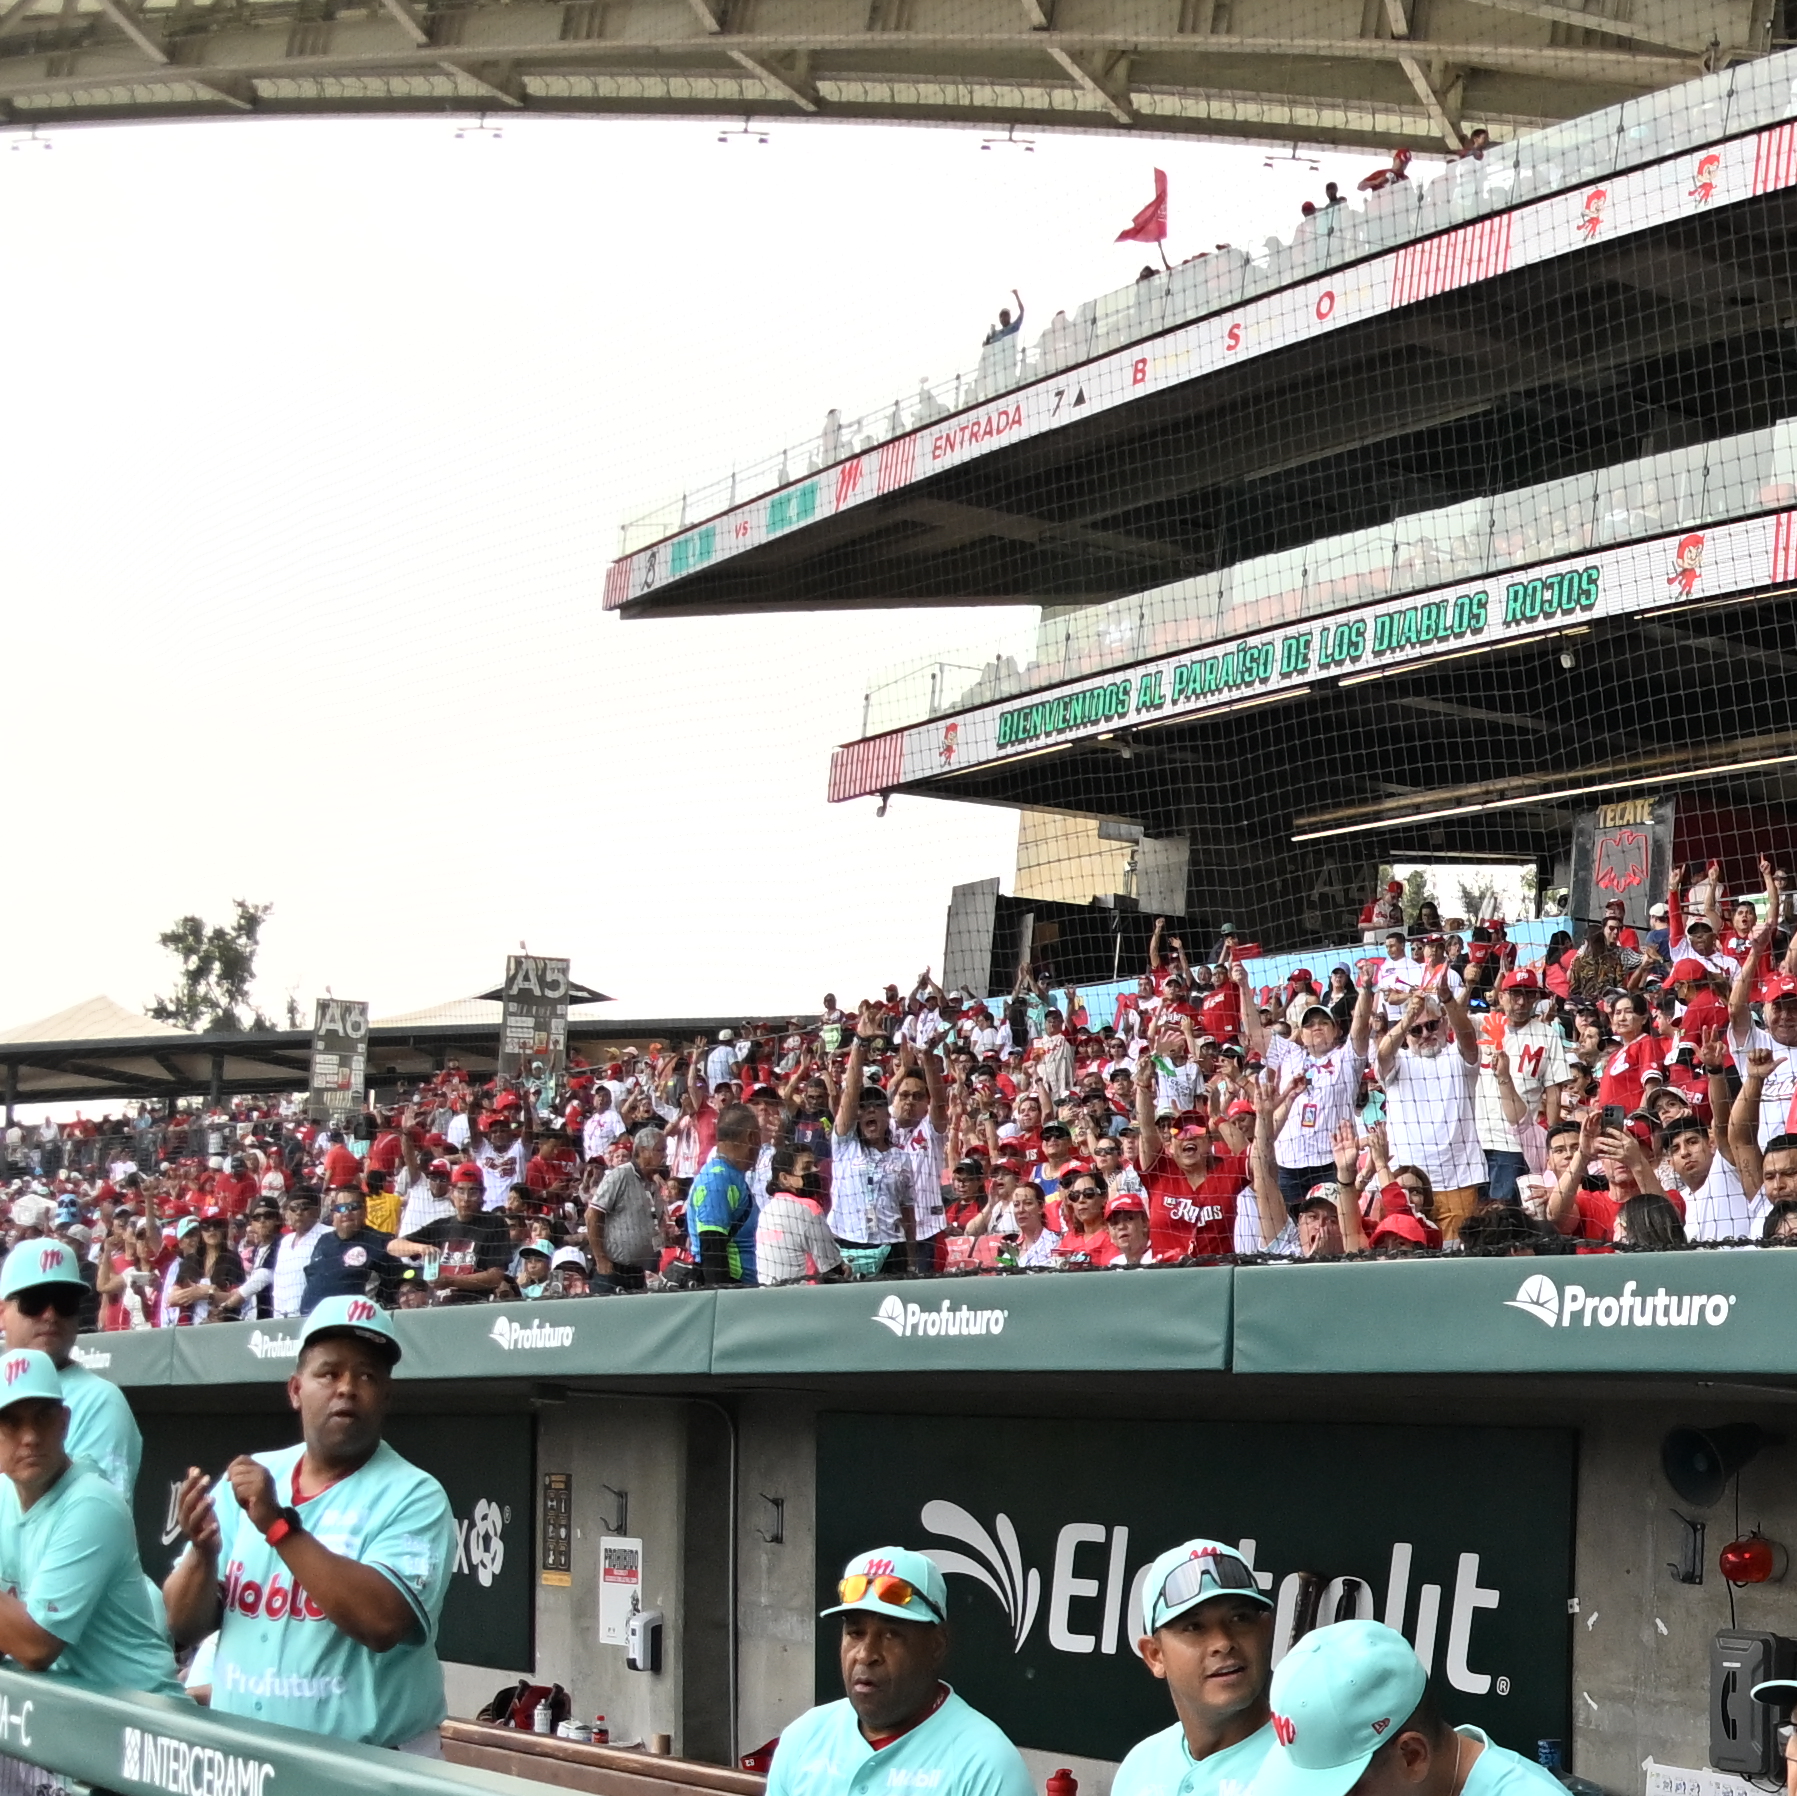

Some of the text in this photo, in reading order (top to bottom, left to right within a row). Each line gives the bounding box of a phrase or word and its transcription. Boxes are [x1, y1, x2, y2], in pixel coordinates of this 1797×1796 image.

[1132, 357, 1148, 386] B
[1226, 323, 1242, 351] S
[931, 403, 1024, 461] ENTRADA
[998, 565, 1600, 746] BIENVENIDOS AL PARAÍSO DE LOS DIABLOS ROJOS
[1596, 797, 1656, 828] TECATE
[510, 958, 568, 999] A5
[318, 1003, 367, 1039] A6
[905, 1299, 1004, 1337] Profuturo
[1562, 1278, 1728, 1327] Profuturo
[510, 1319, 572, 1351] Profuturo
